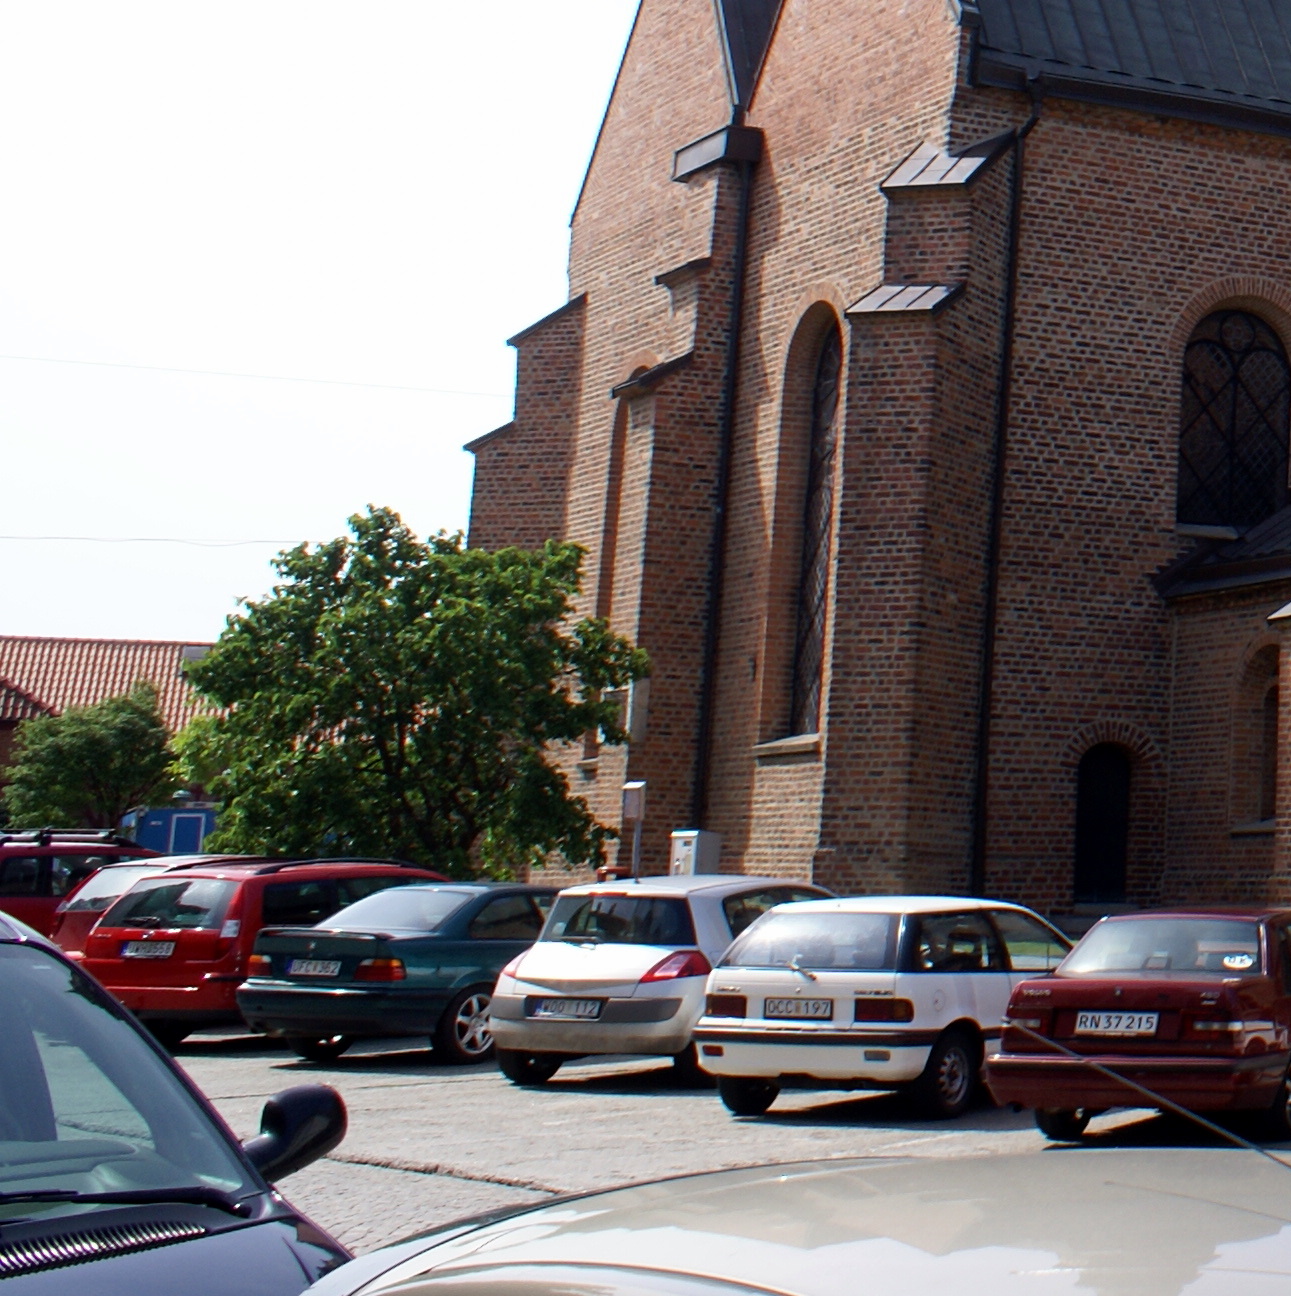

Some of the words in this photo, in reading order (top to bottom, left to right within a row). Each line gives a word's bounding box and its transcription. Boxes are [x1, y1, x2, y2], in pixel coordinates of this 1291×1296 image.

[575, 1001, 597, 1014] 112
[768, 1001, 793, 1014] OCC
[804, 1002, 829, 1015] 197
[1079, 1015, 1101, 1029] RN
[1103, 1015, 1123, 1029] 37
[1126, 1015, 1154, 1030] 215
